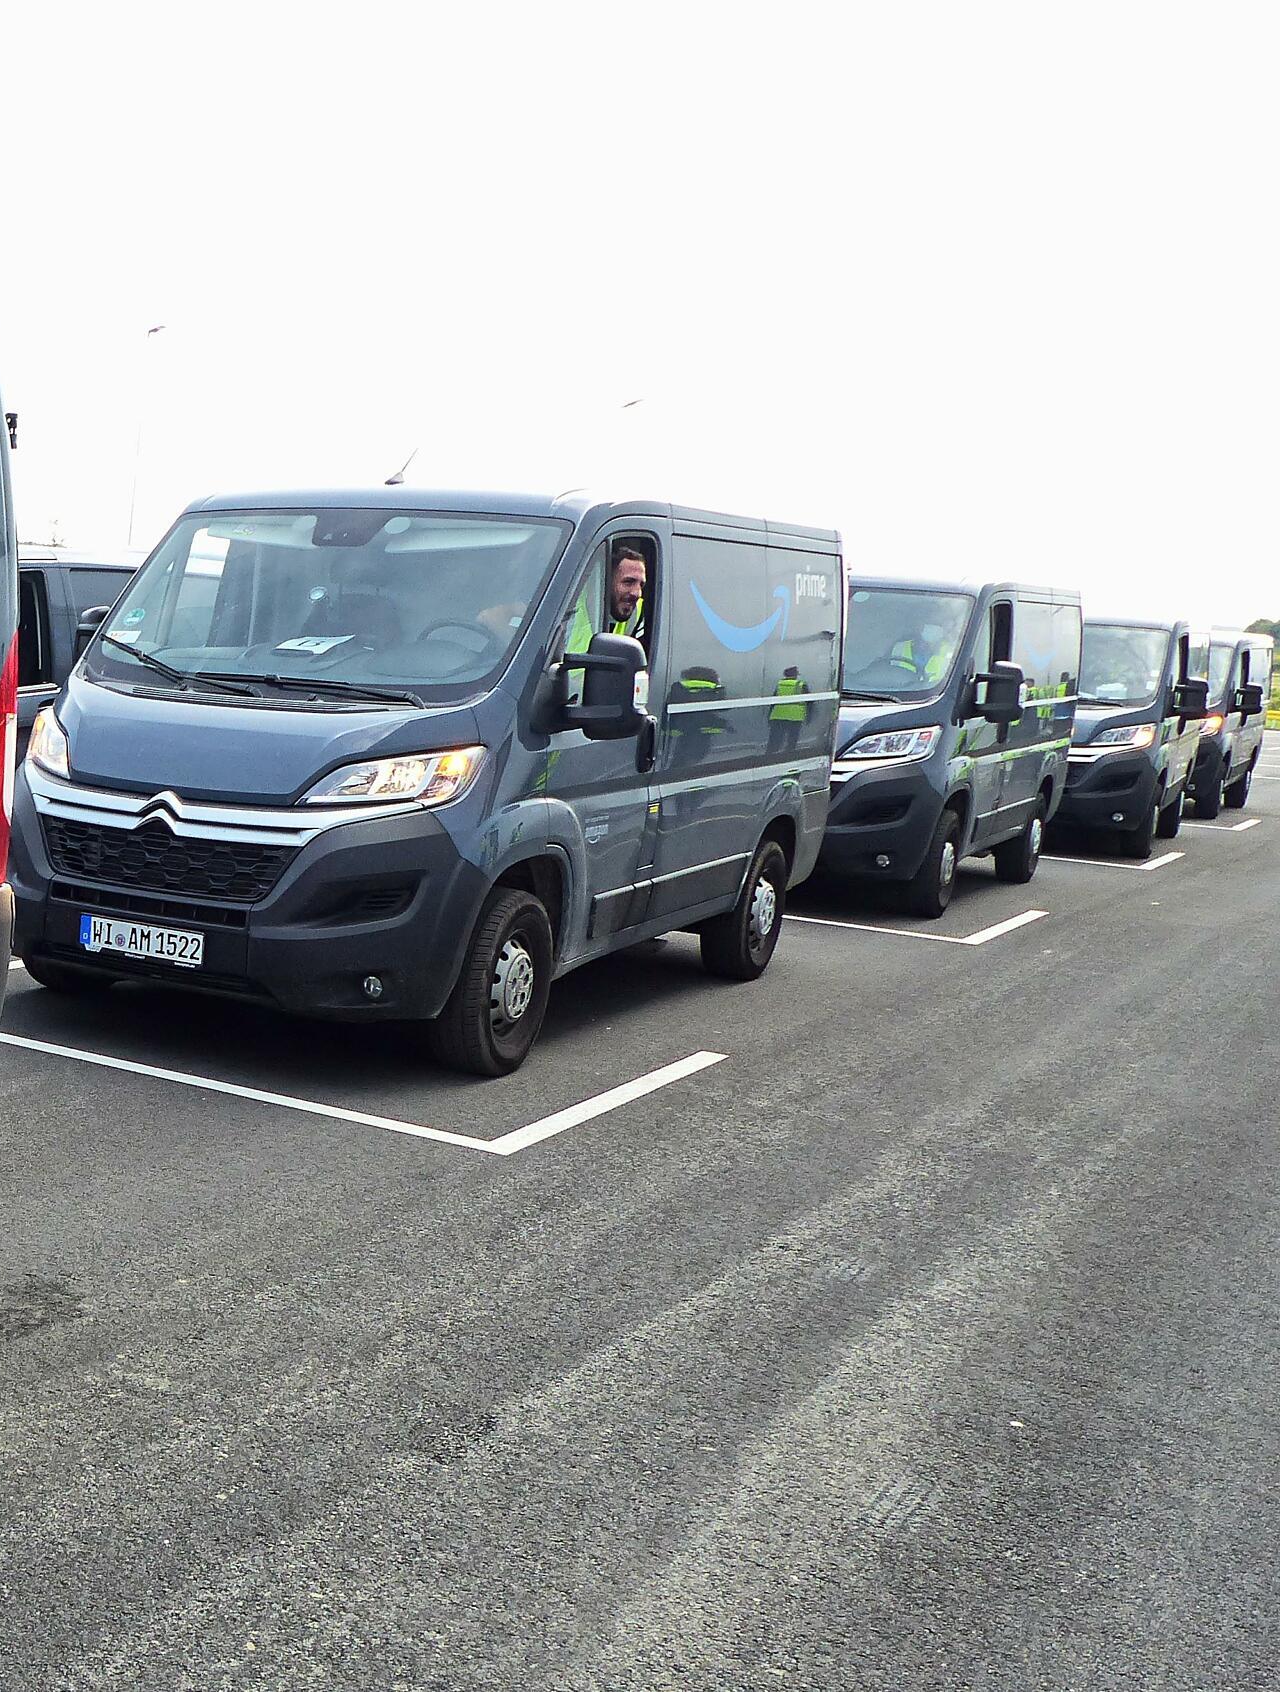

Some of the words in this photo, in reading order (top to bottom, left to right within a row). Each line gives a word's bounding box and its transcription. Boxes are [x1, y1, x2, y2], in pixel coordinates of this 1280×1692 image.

[795, 565, 826, 605] prime
[127, 927, 152, 953] AM
[154, 931, 202, 961] 1522
